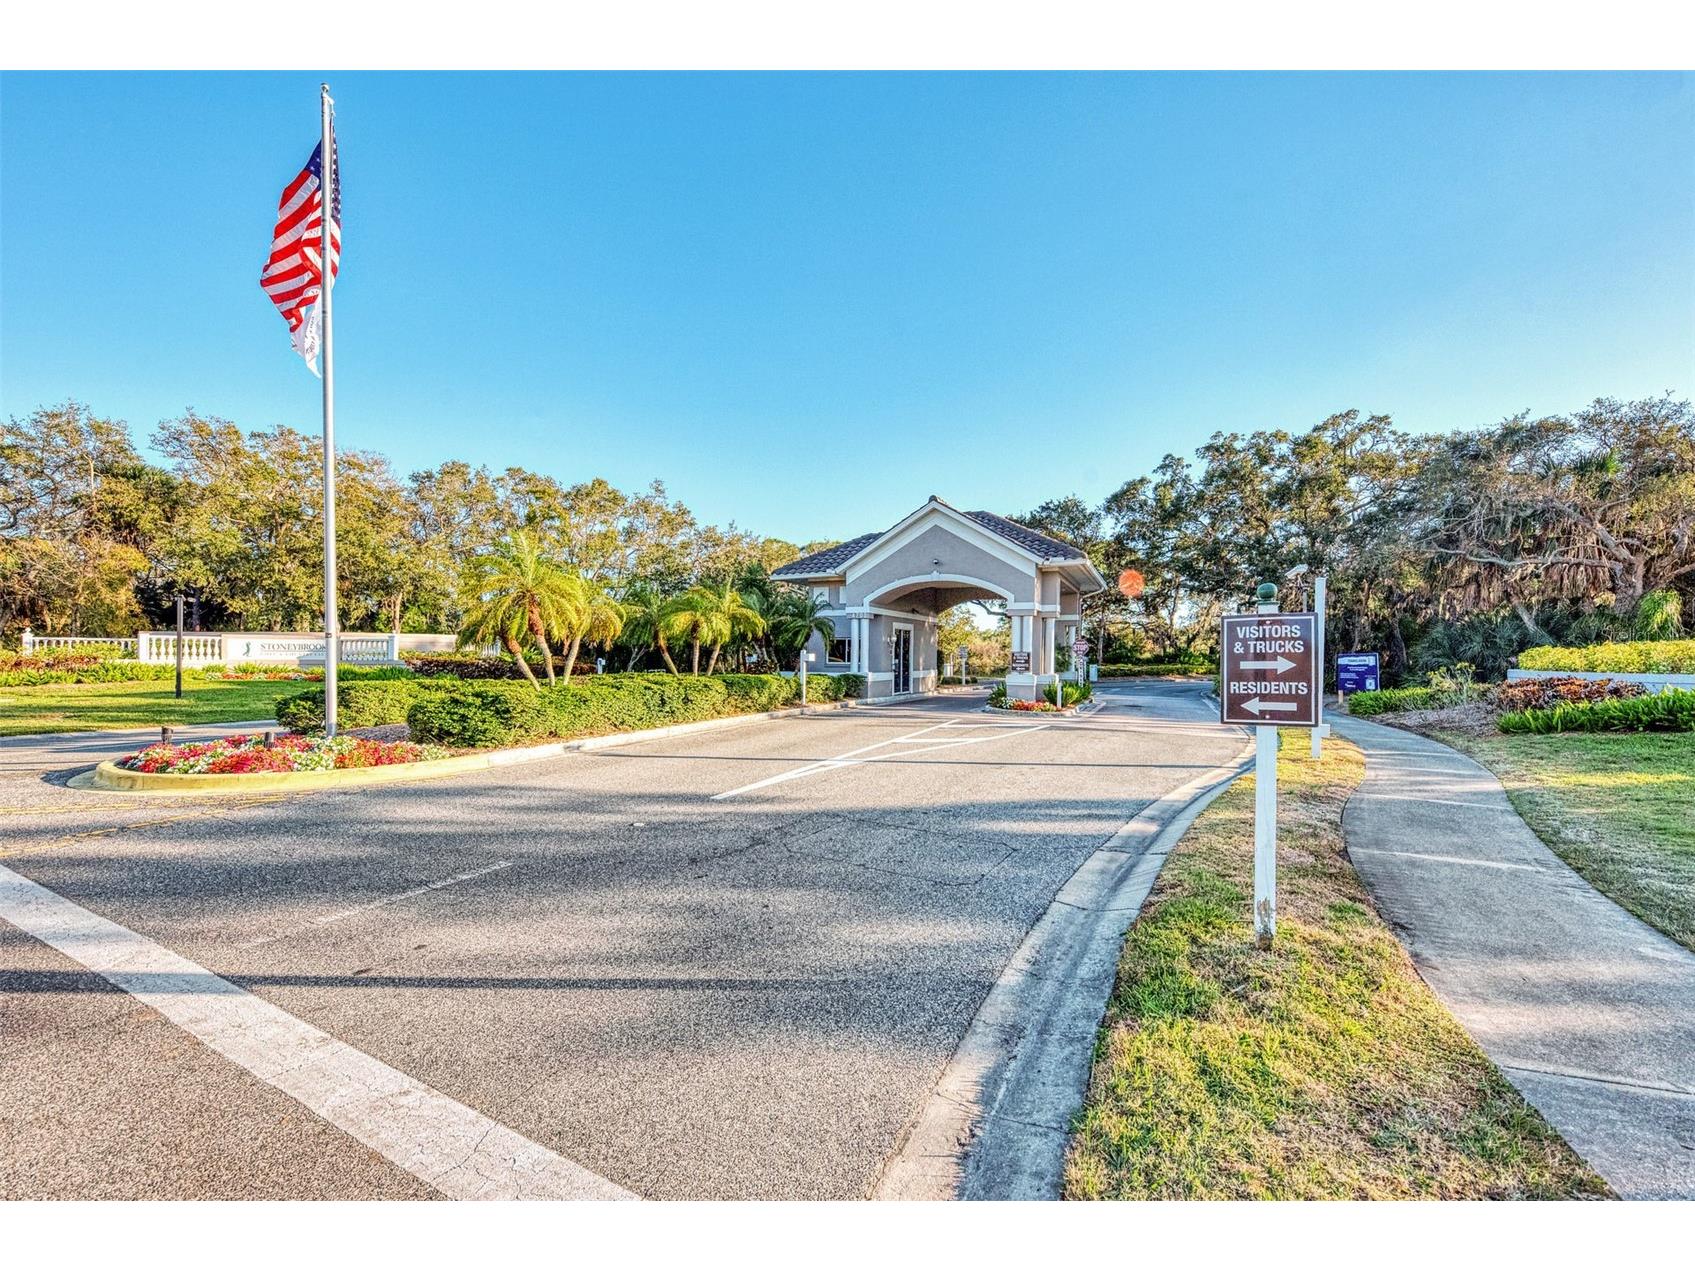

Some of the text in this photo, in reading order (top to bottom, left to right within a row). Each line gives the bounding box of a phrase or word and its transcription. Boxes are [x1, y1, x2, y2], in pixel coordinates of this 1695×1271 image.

[1236, 625, 1301, 639] VISITORS
[1233, 640, 1305, 654] & TRUCKS
[1230, 681, 1308, 695] RESIDENTS
